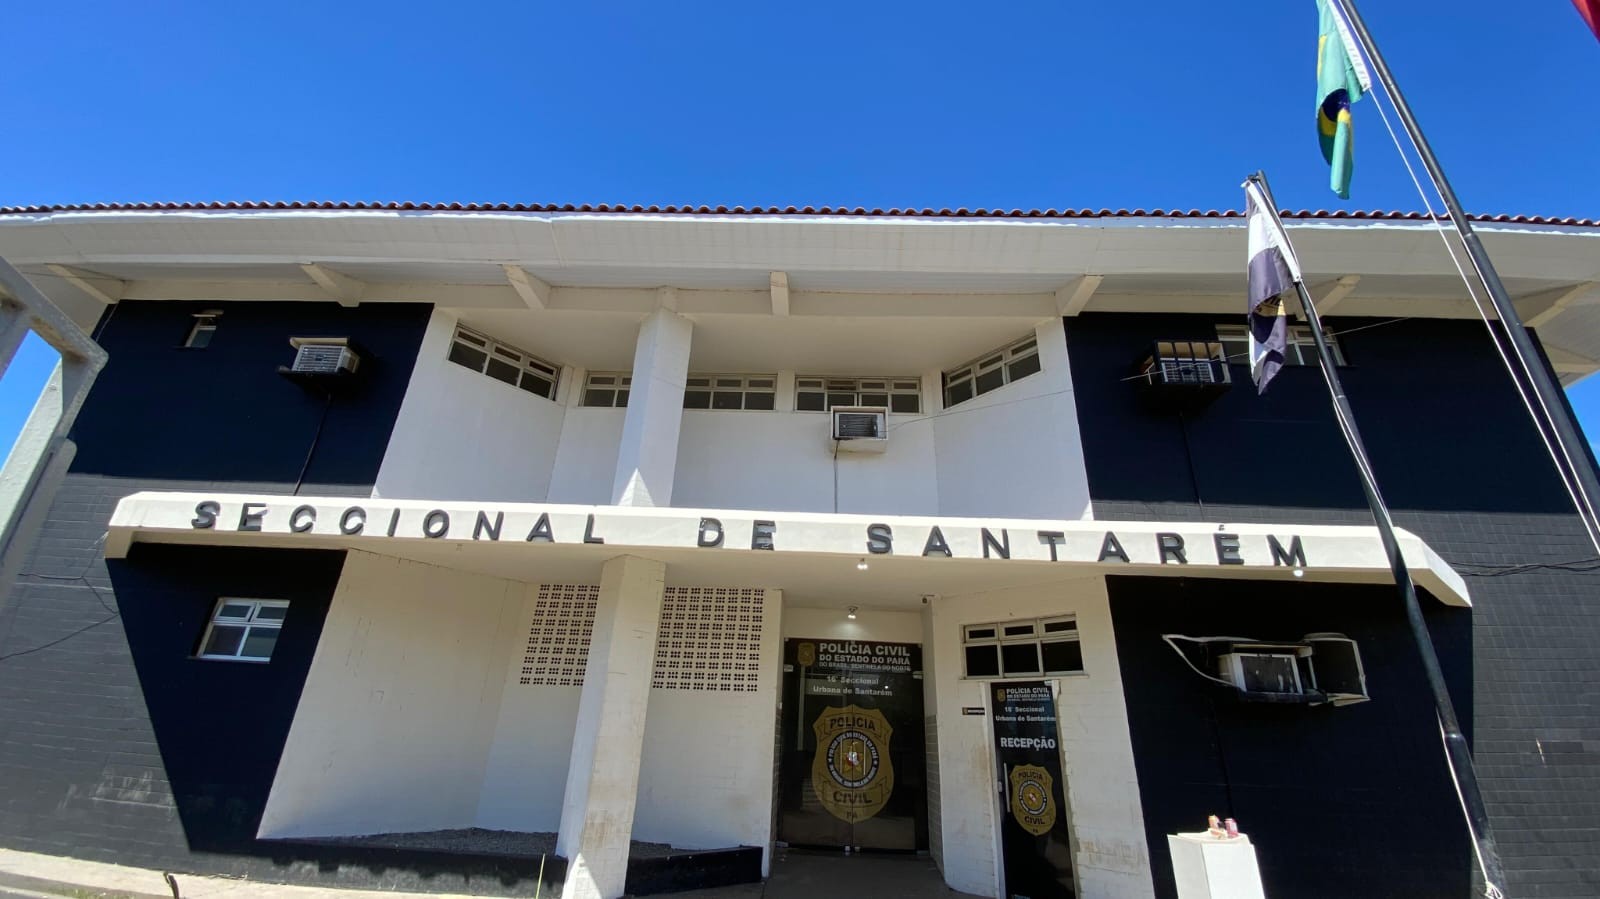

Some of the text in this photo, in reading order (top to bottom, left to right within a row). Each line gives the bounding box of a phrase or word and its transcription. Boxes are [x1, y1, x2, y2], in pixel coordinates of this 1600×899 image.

[191, 500, 1308, 569] SECCIONAL DE SANTARÉM
[819, 642, 911, 657] POLÍCIA CIVIL
[819, 654, 911, 665] DO ESTADO DO PARÁ
[840, 676, 879, 685] Seccional
[813, 685, 893, 696] Urbana de Santarém
[1000, 736, 1056, 751] RECEPÇÃO
[833, 791, 872, 803] CIVIL
[1024, 816, 1045, 825] CIVIL
